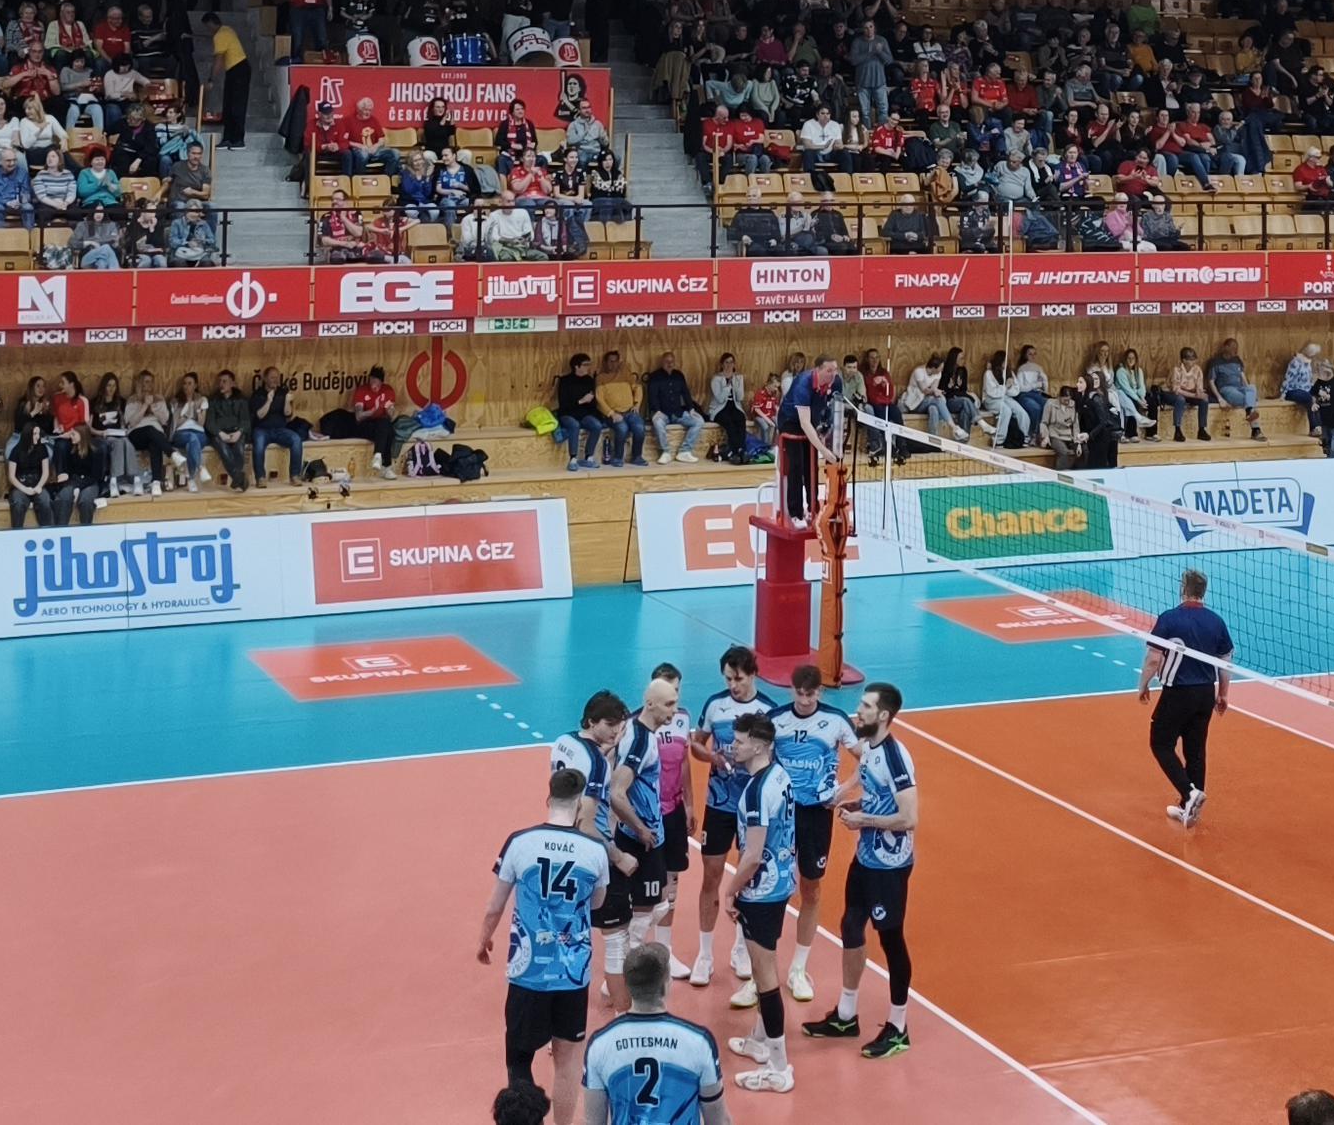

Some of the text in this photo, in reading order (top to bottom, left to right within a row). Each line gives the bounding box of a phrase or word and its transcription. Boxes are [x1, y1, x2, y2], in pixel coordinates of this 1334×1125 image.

[388, 83, 516, 103] JIHOSTROJ FANS
[756, 268, 825, 284] HINTON
[895, 273, 960, 289] FINAPRA
[1033, 270, 1130, 284] JIHOTRANS
[606, 273, 708, 294] SKUPINA ČEZ
[340, 270, 454, 314] EGE
[956, 306, 981, 316] HOCH
[1090, 304, 1114, 314] HOCH
[1172, 302, 1204, 313] HOCH
[1298, 300, 1328, 310] HOCH
[764, 311, 800, 322] HOCH
[863, 308, 889, 318] HOCH
[433, 320, 463, 331] HOCH
[616, 315, 653, 327] HOCH
[90, 329, 123, 341] HOCH
[203, 326, 245, 339] HOCH
[323, 323, 354, 335] HOCH
[1194, 487, 1294, 517] MADETA
[946, 506, 1088, 541] Chance
[389, 539, 515, 567] SKUPINA ČEZ
[41, 606, 68, 617] AERO
[71, 602, 136, 615] TECHNOLOGY
[151, 597, 211, 610] HYDRAULICS
[309, 669, 419, 683] SKUPINA
[659, 731, 673, 744] 16
[794, 730, 807, 743] 12
[544, 841, 575, 853] KOVÁČ
[536, 856, 578, 901] 14
[644, 880, 660, 897] 10
[615, 1036, 679, 1051] GOTTESMAN
[633, 1056, 661, 1106] 2
